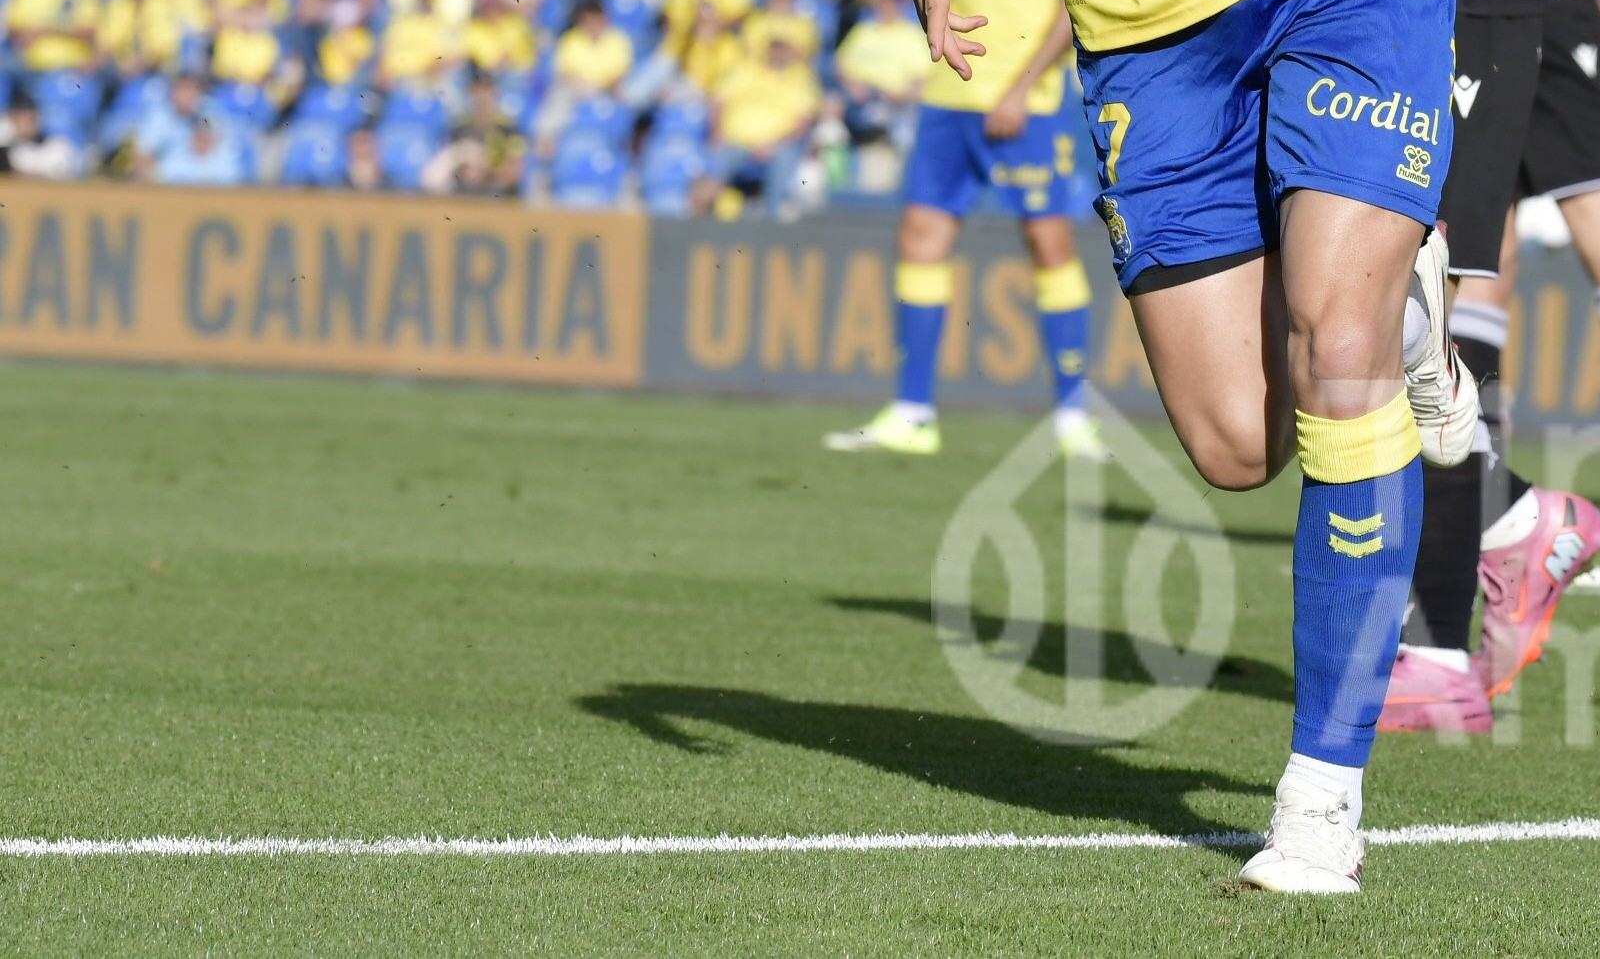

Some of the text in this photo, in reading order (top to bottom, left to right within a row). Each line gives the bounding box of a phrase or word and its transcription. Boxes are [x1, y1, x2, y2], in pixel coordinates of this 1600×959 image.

[1097, 102, 1132, 185] 7
[1306, 77, 1440, 146] Cordial
[1399, 166, 1429, 186] hummel
[184, 217, 611, 357] CANARIA
[687, 244, 893, 375] UNA
[940, 255, 1158, 387] ISA
